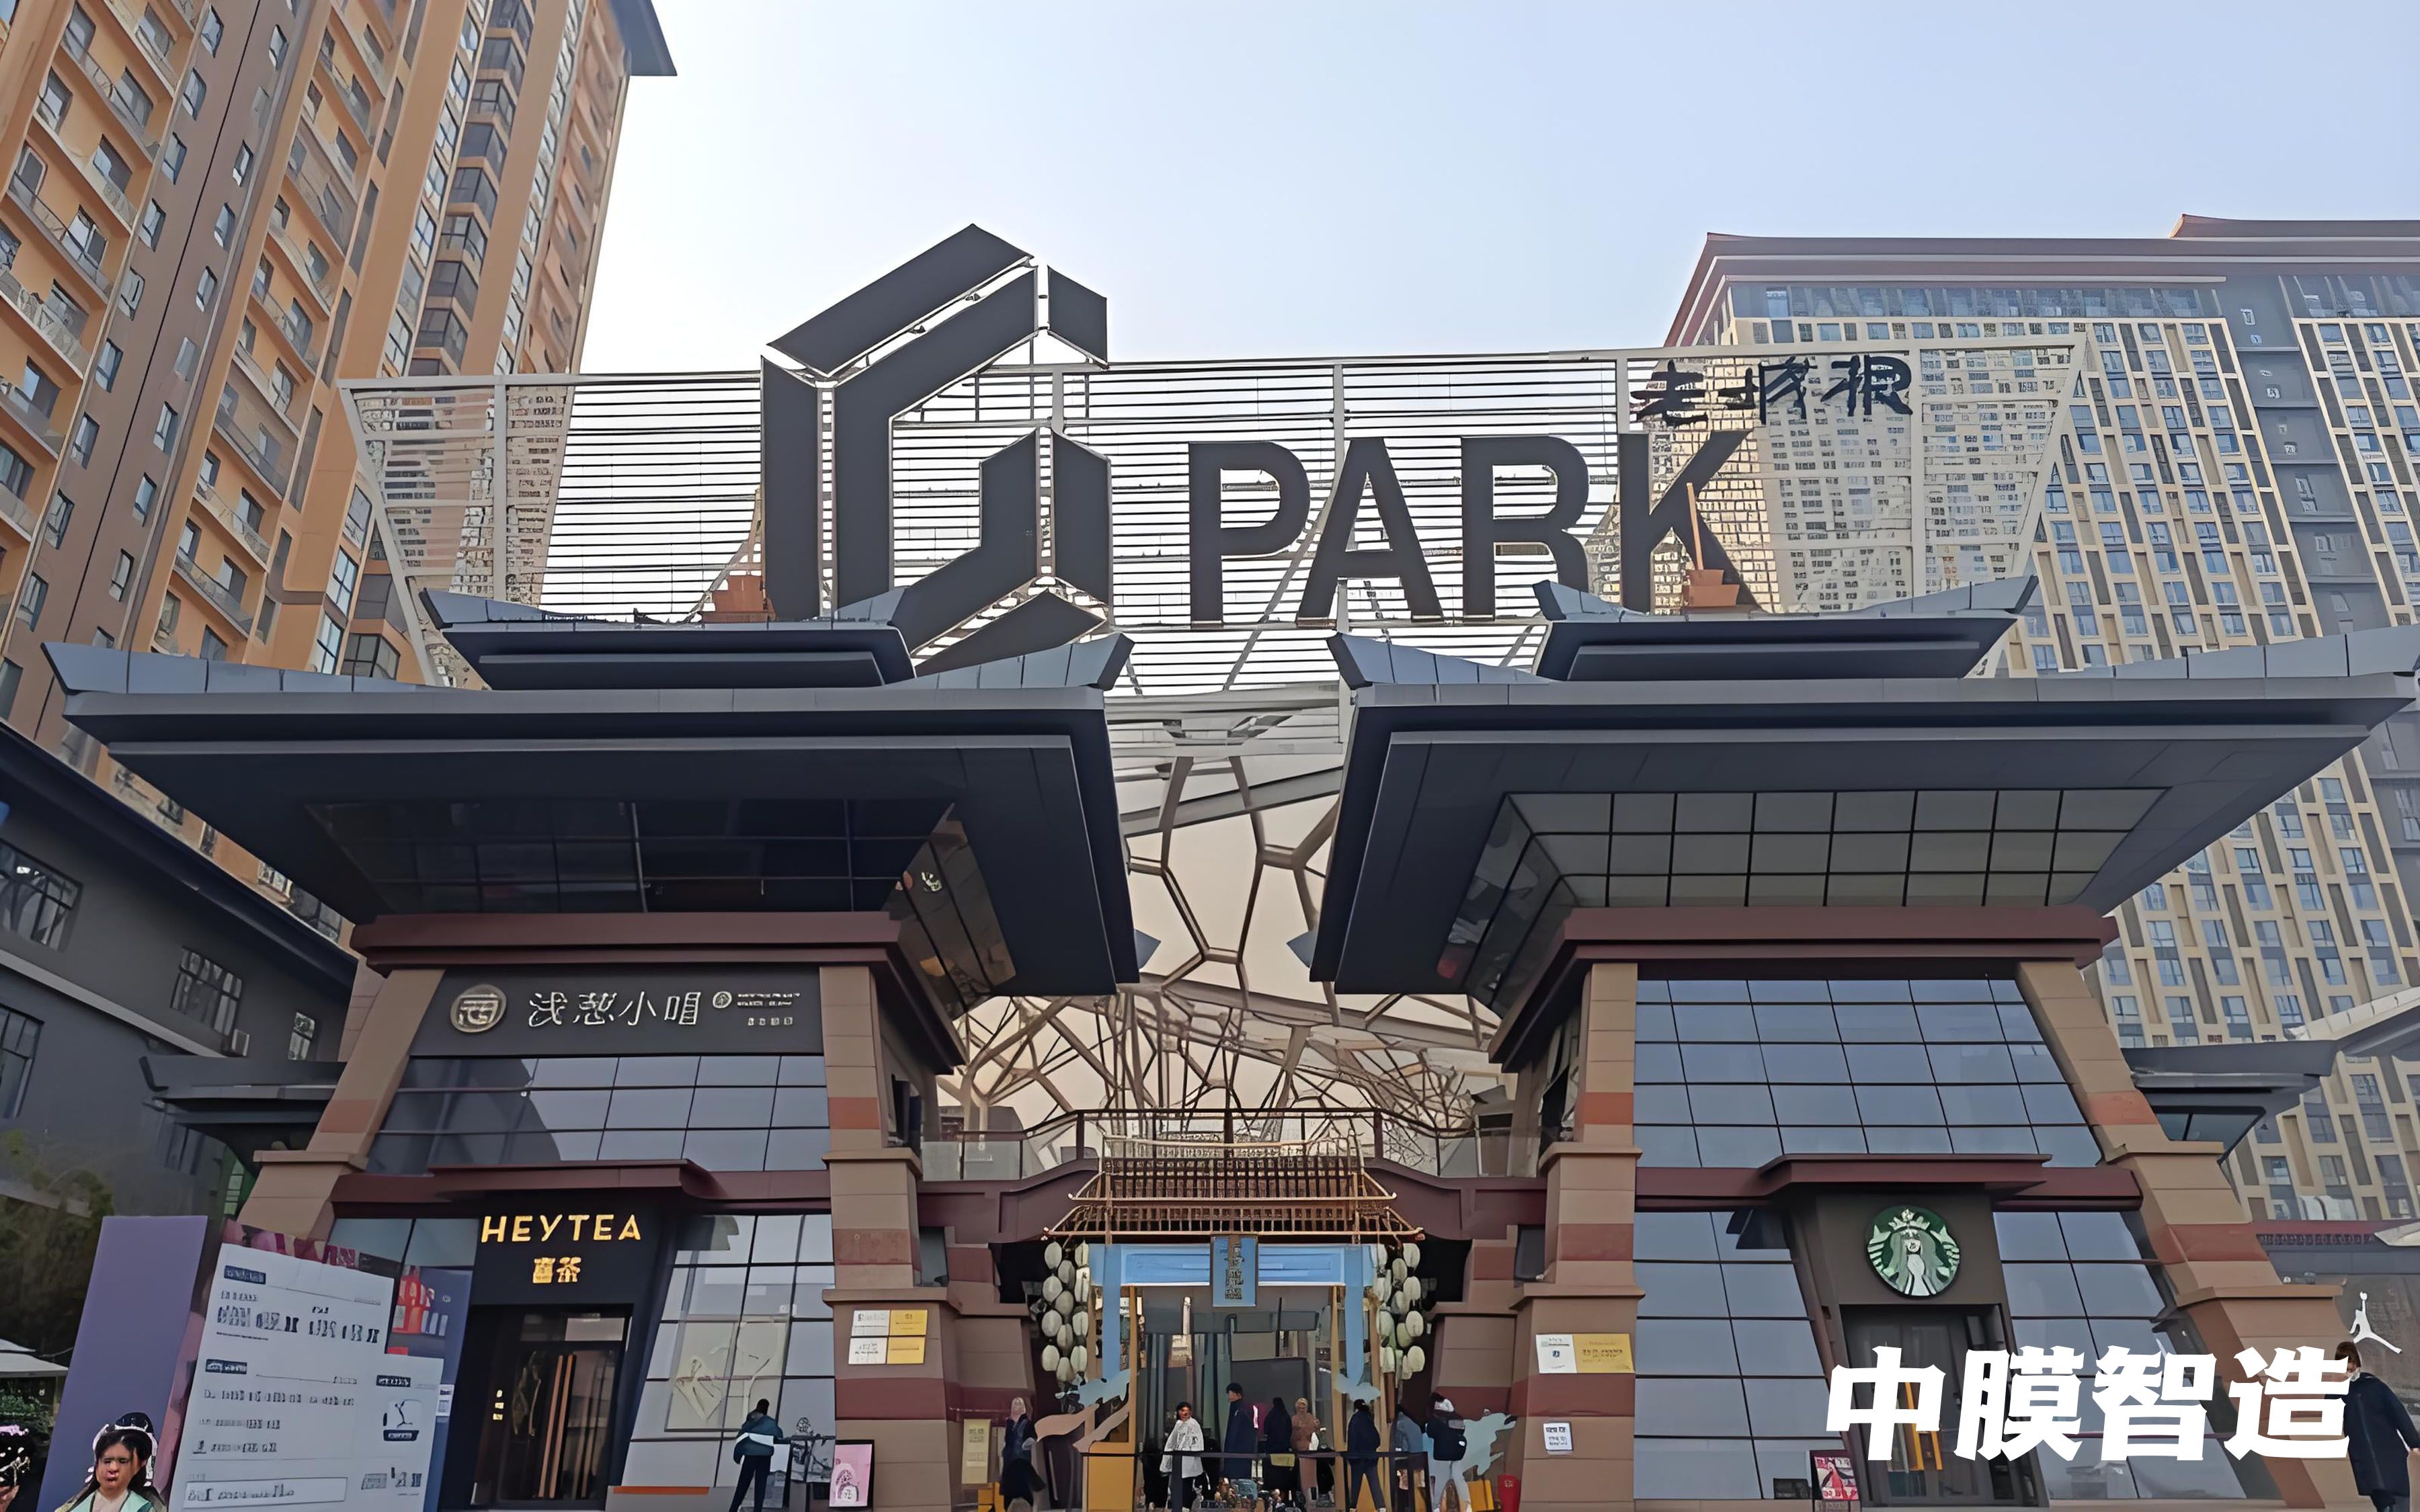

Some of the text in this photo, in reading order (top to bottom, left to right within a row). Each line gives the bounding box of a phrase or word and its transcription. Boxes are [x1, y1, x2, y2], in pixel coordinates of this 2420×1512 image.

[1188, 430, 1759, 628] PARK
[481, 1214, 641, 1243] HEYTEA
[532, 1256, 582, 1284] 喜茶
